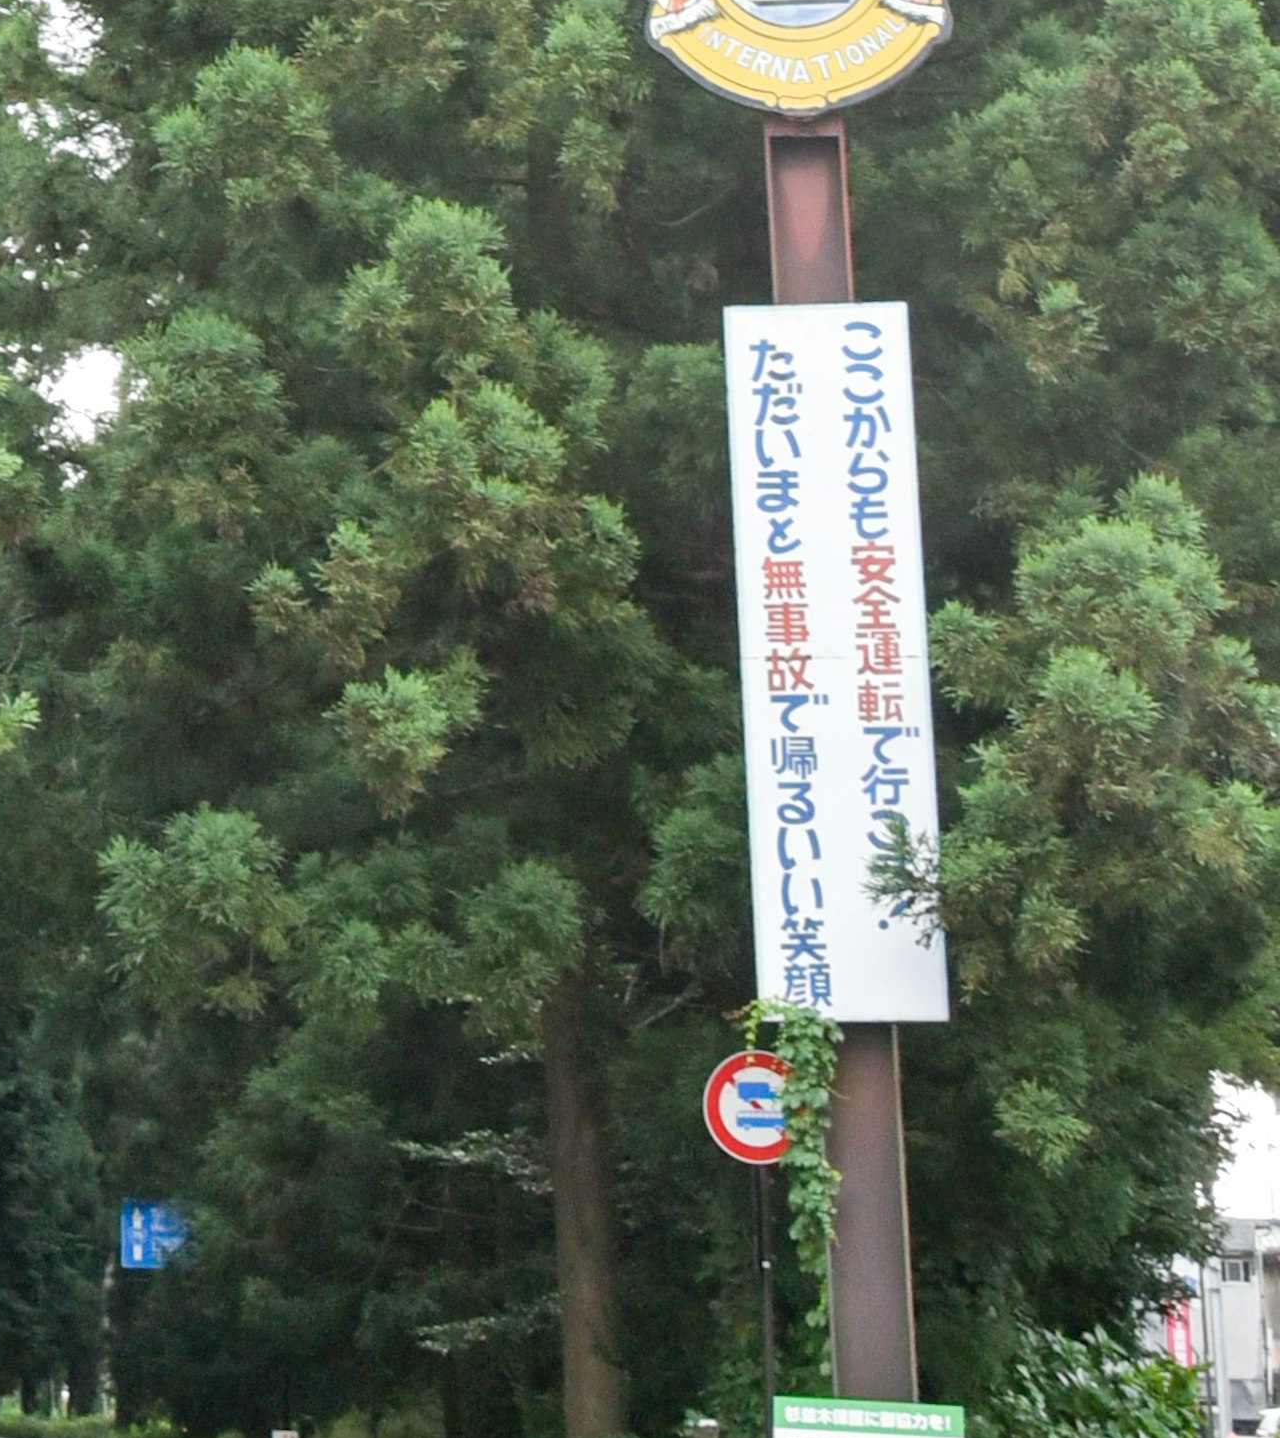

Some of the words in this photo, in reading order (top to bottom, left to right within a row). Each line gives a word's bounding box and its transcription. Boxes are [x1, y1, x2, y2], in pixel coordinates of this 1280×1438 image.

[696, 16, 911, 84] INTERNATIONAL
[749, 339, 833, 1007] ただいまと無事故で帰るいい笑顔
